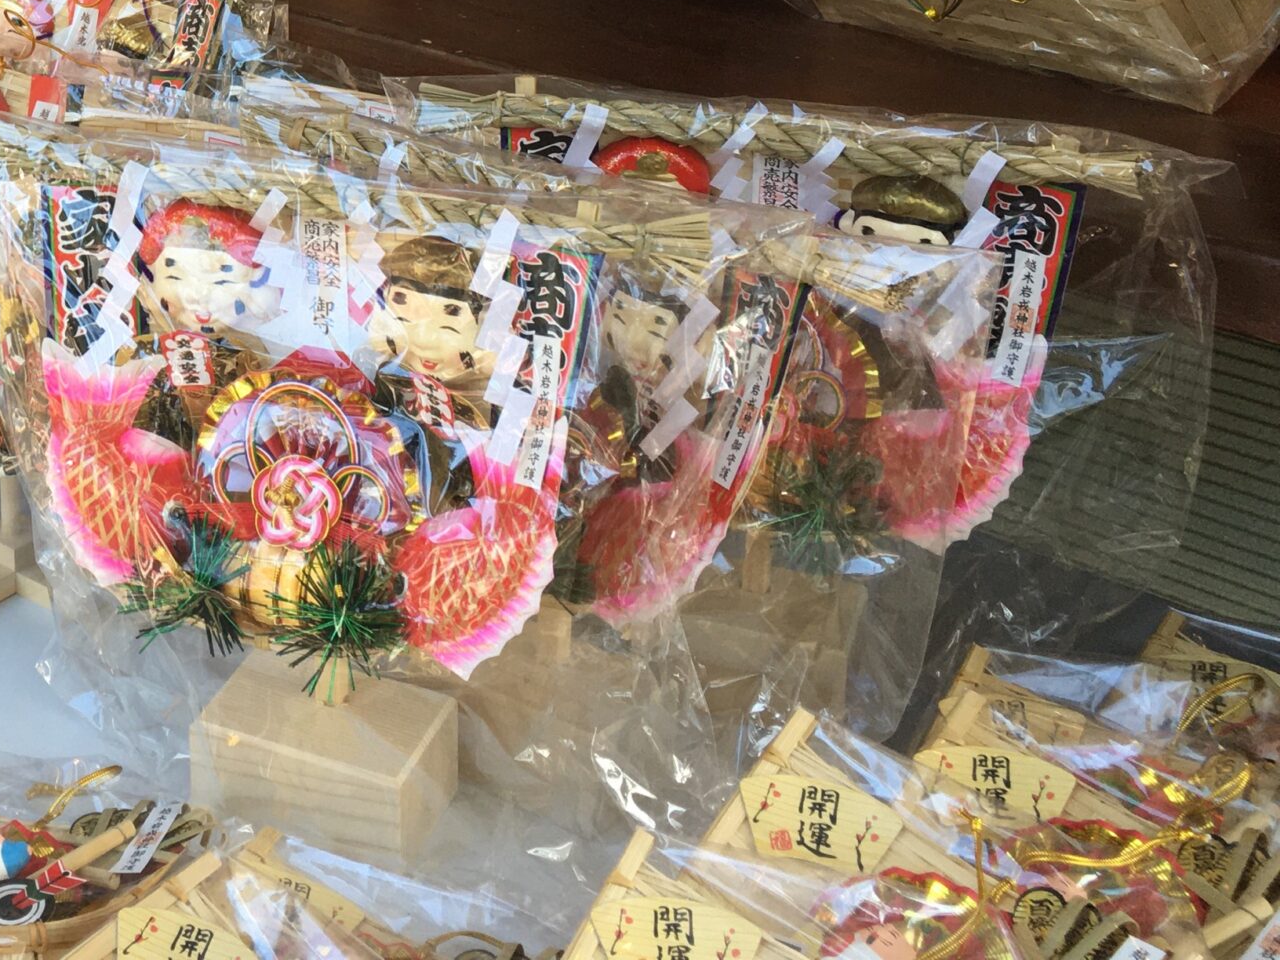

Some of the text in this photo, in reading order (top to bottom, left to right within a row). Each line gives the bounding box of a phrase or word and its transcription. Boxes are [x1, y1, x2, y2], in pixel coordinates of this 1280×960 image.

[322, 220, 342, 290] 家内安全
[308, 295, 336, 337] 御守
[971, 754, 1017, 821] 開運
[796, 785, 841, 860] 開運
[175, 924, 215, 960] 開
